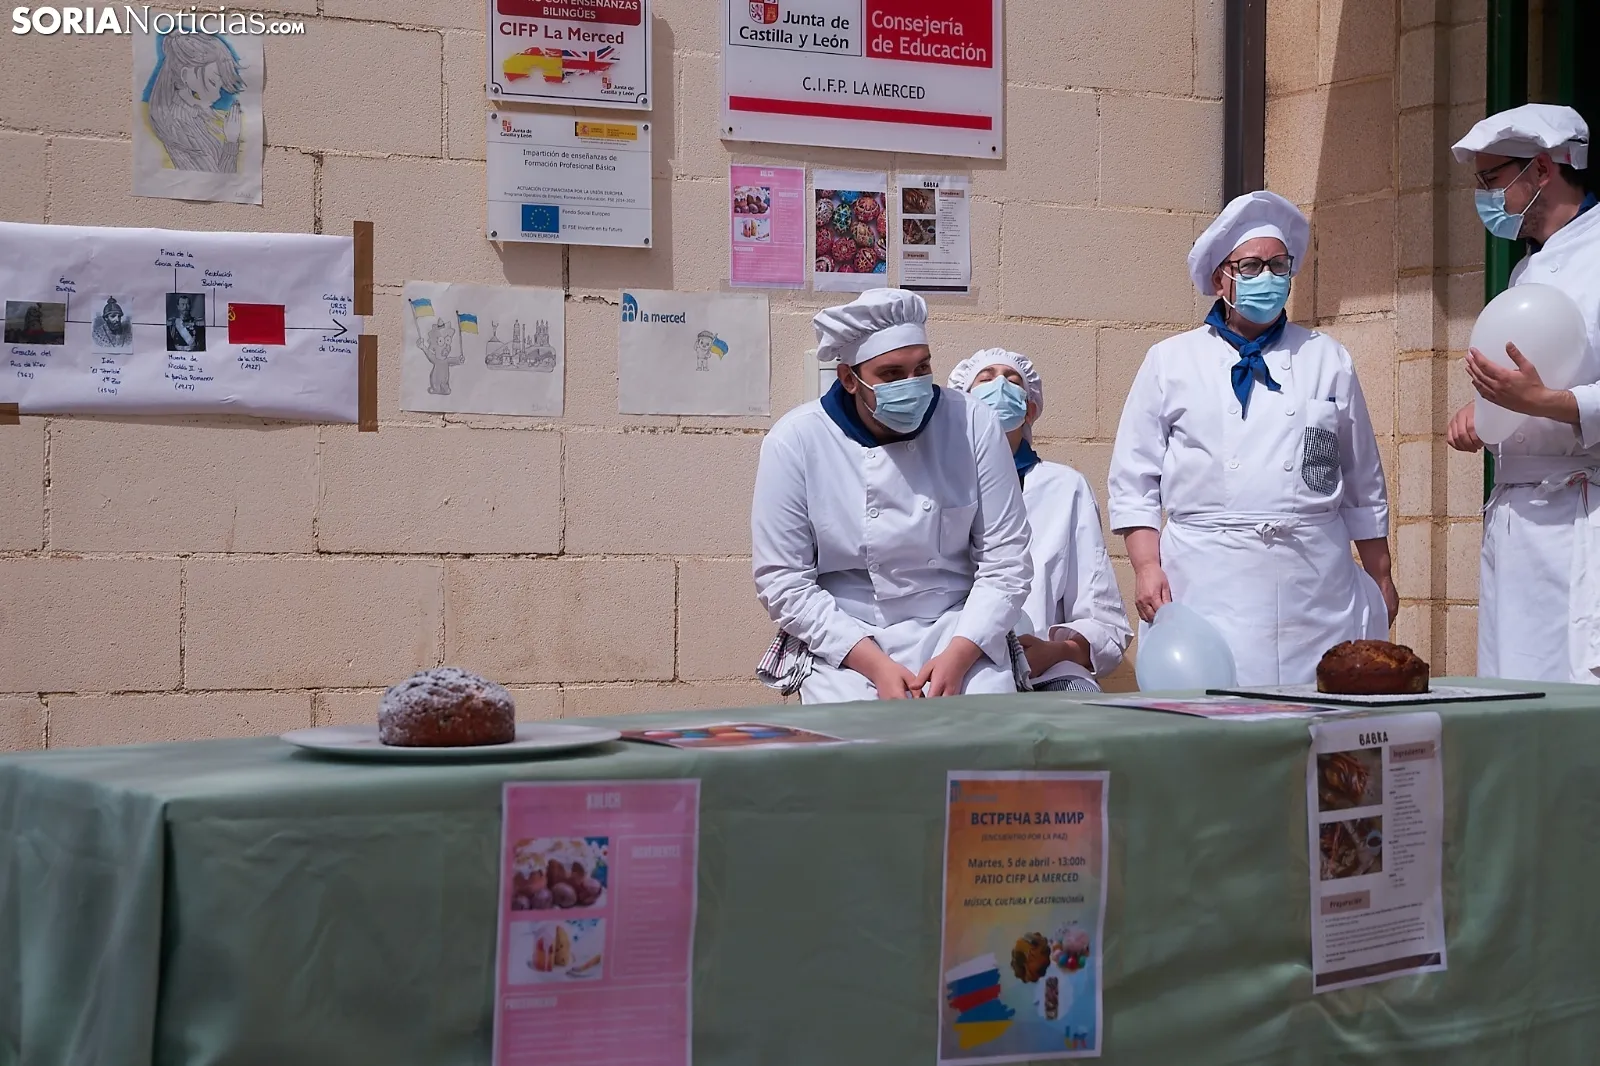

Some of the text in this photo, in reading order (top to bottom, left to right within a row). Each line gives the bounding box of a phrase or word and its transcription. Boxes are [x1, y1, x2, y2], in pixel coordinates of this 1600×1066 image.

[543, 6, 596, 20] BILINGÜES
[783, 10, 850, 30] Junta de
[871, 10, 963, 37] Consejería
[500, 22, 624, 44] CIFP La Merced
[739, 26, 849, 49] Castilla y León
[871, 34, 987, 62] de Educación
[802, 76, 926, 100] C.I.F.P. LA MERCED
[523, 149, 560, 158] Impartición
[571, 152, 607, 161] enseñanzas
[609, 154, 618, 162] de
[524, 160, 616, 172] Formación Profesional Básica
[640, 310, 686, 324] la merced
[971, 810, 1085, 826] ВСТРЕЧА ЗА МИР
[968, 858, 1005, 869] Martes,
[1007, 858, 1013, 868] 5
[1015, 856, 1026, 868] de
[1028, 856, 1050, 868] abril
[1058, 856, 1086, 867] 13:00h
[974, 872, 1079, 885] PATIO CIFP LA MERCED
